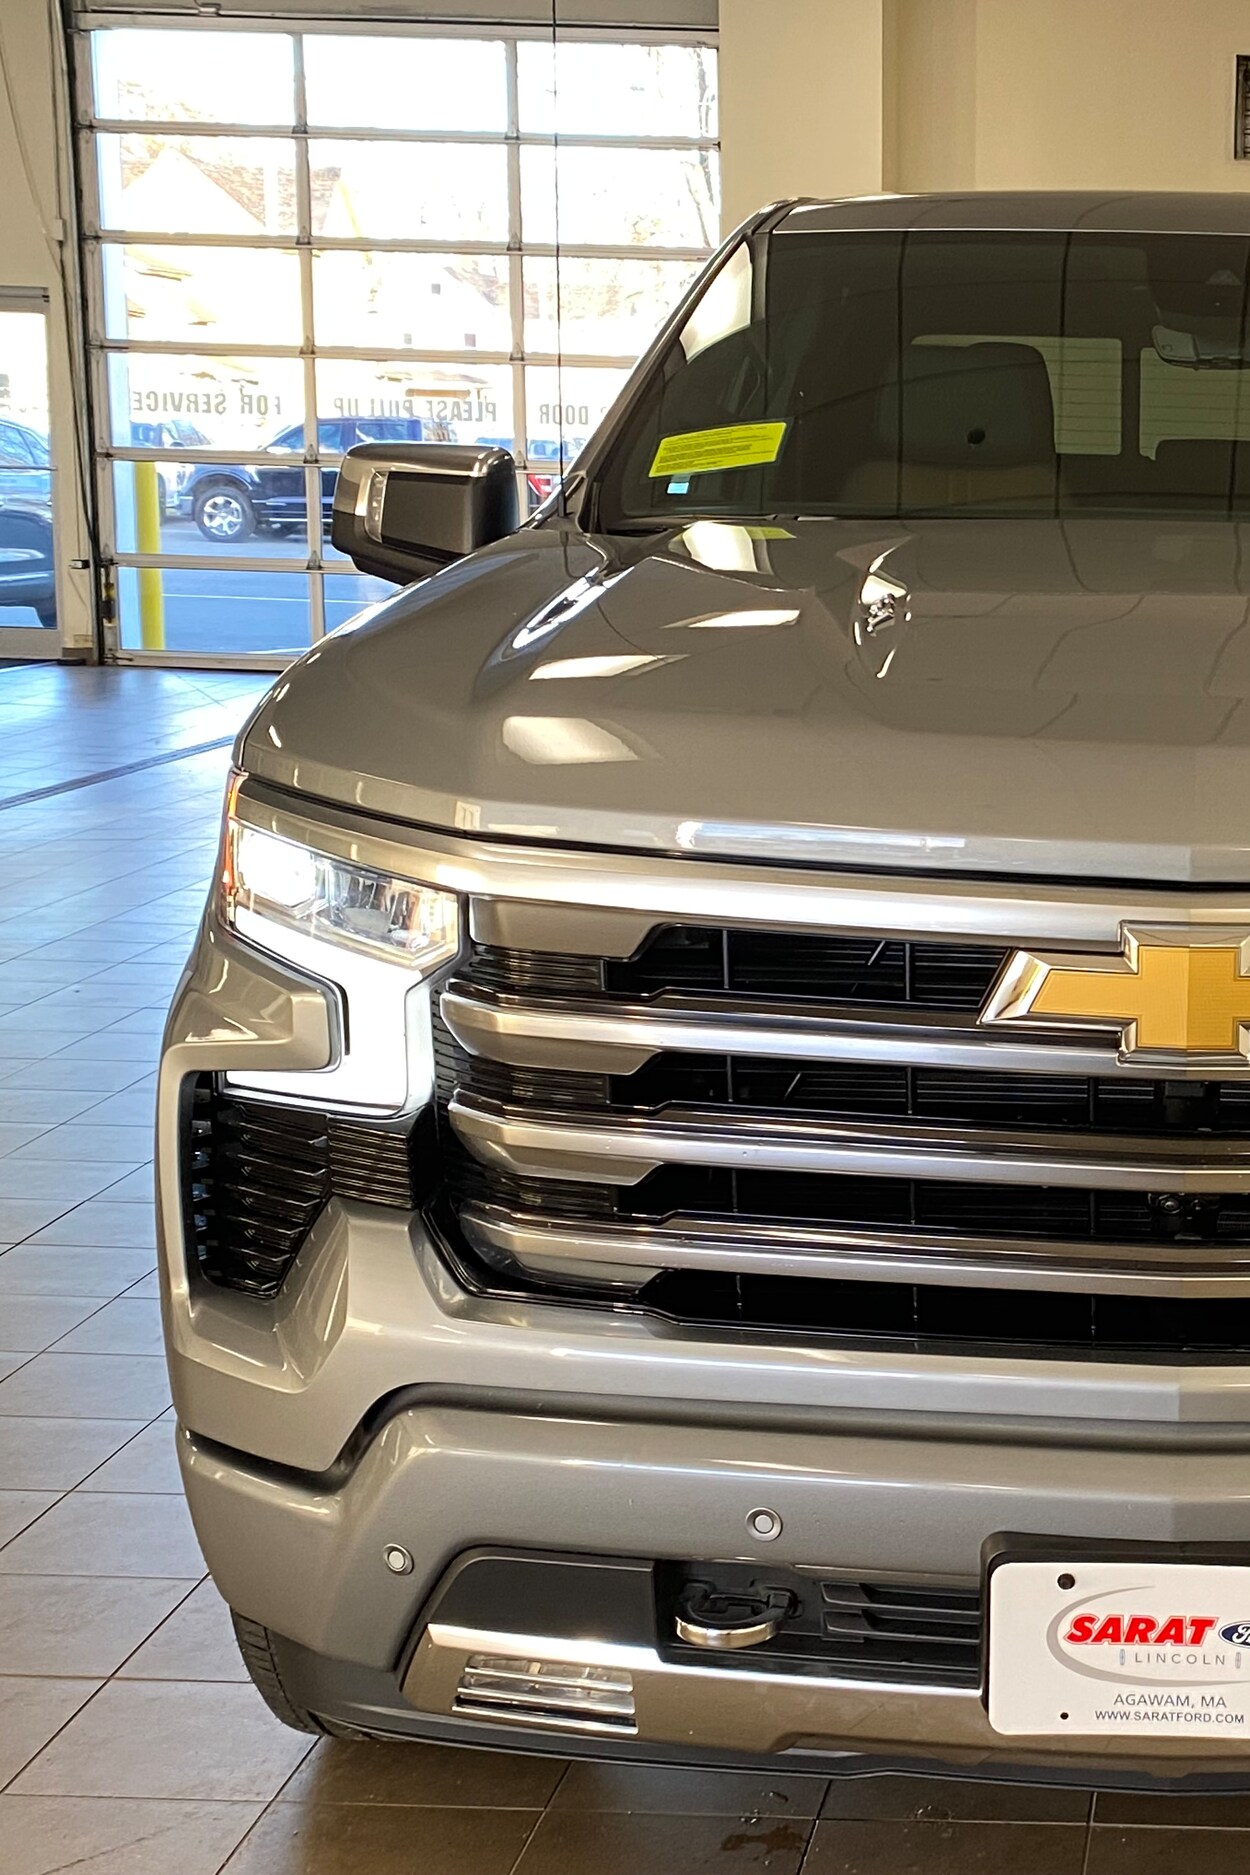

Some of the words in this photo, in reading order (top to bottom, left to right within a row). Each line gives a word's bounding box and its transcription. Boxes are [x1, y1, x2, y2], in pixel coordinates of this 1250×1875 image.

[1063, 1613, 1219, 1647] SARAT
[1134, 1652, 1226, 1666] LINCOLN
[1113, 1693, 1195, 1708] AGAWAM,
[1201, 1696, 1227, 1708] MA
[1095, 1709, 1245, 1724] WWW.SARATFORD.COM
